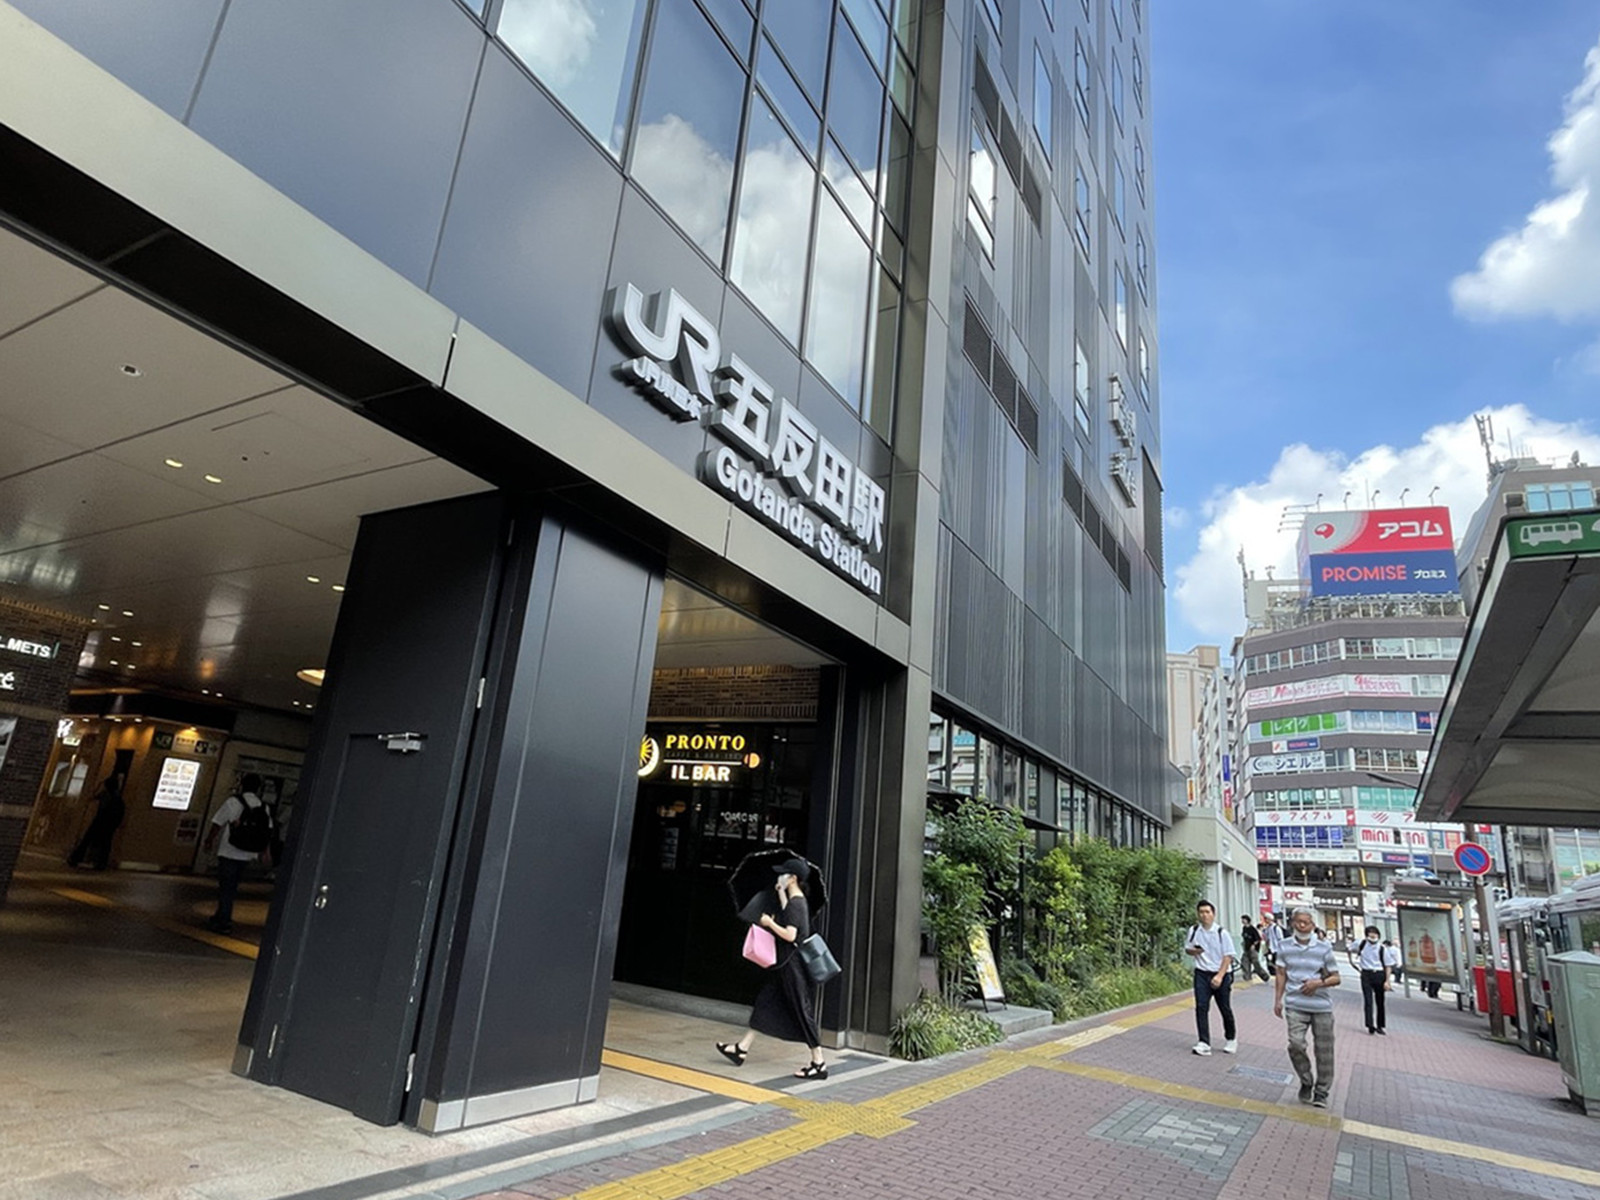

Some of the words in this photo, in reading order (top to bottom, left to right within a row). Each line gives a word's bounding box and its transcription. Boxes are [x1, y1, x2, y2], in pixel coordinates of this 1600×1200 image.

[621, 281, 721, 404] JR
[719, 353, 886, 552] 五反田駅
[715, 446, 816, 548] Gotanda
[817, 522, 881, 596] Station
[1378, 519, 1444, 539] アコム
[1322, 565, 1407, 582] PROMISE
[1413, 569, 1447, 579] プロミス
[7, 638, 51, 659] METS
[665, 735, 745, 750] PRONTO
[671, 764, 690, 780] IL
[692, 765, 731, 781] BAR
[1361, 829, 1389, 843] mini
